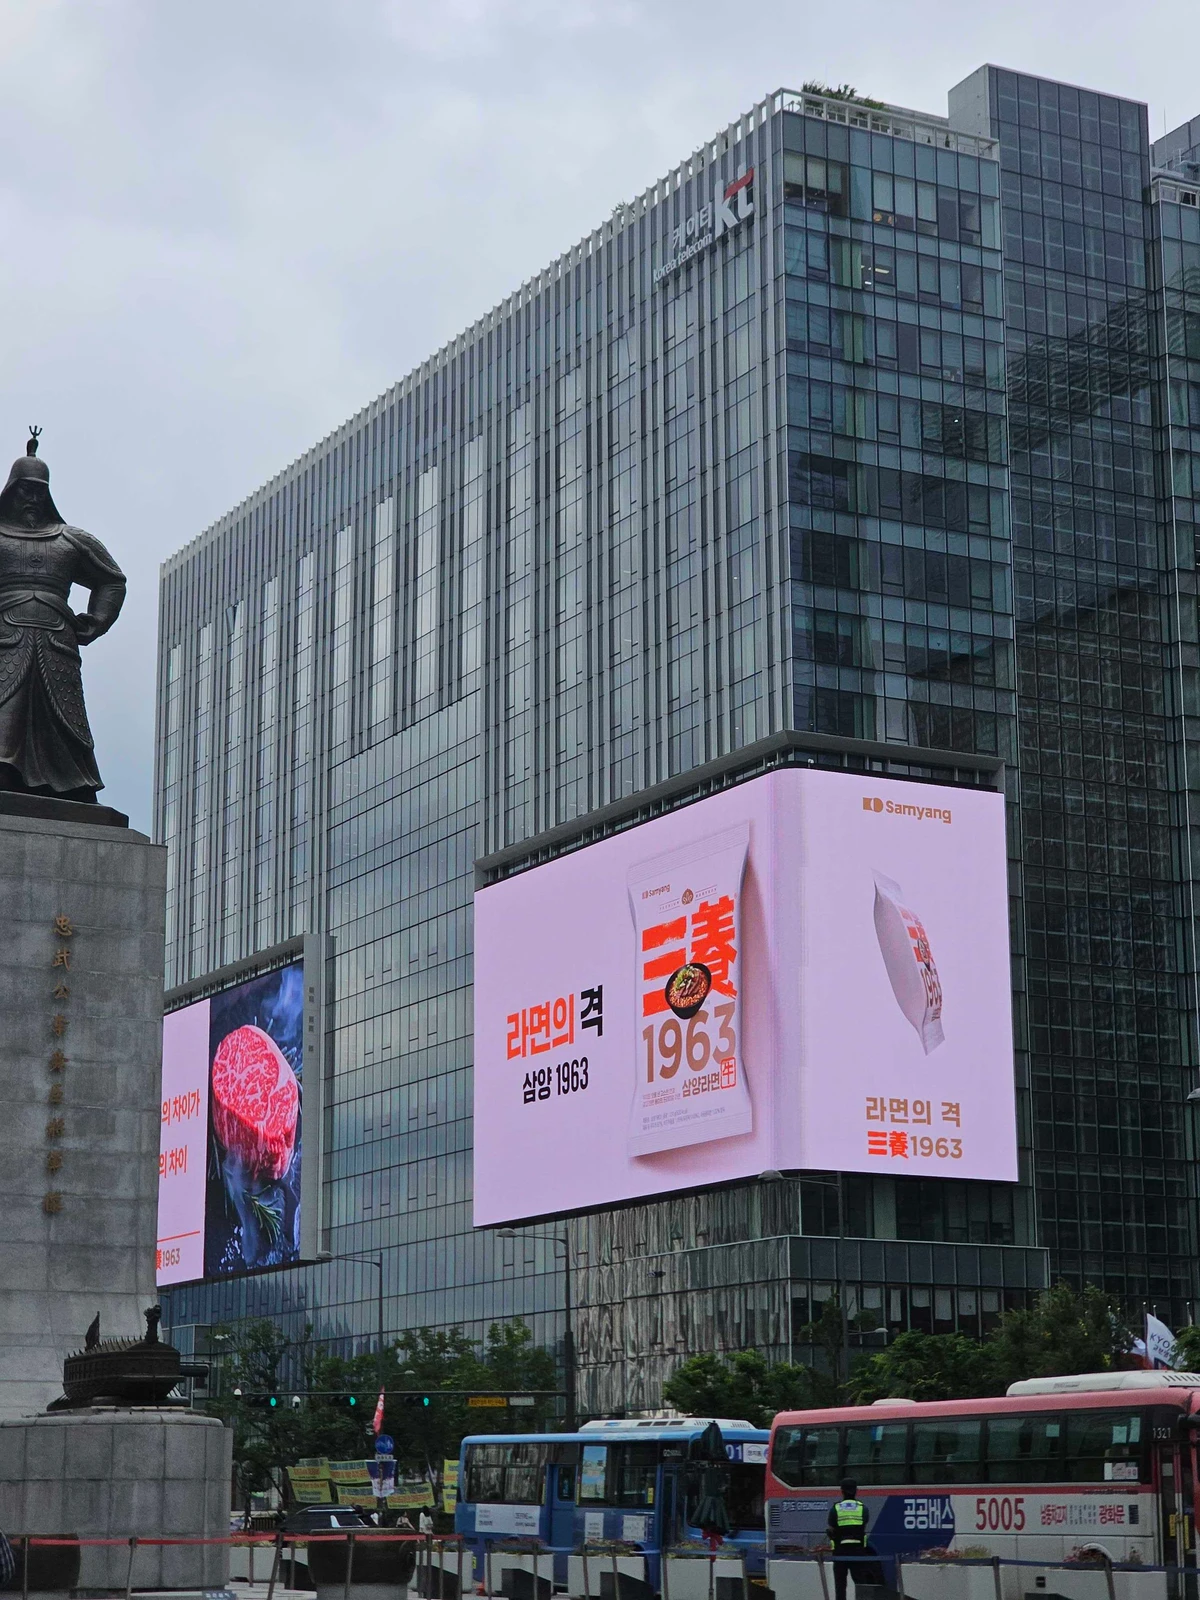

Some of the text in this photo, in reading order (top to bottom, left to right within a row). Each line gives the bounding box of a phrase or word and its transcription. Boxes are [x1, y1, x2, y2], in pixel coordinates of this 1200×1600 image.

[715, 163, 754, 240] kt
[672, 202, 712, 248] 케이티
[886, 800, 951, 824] Samyang
[507, 984, 603, 1060] 라면의 격
[642, 1002, 736, 1083] 1963
[523, 1057, 589, 1104] 삼양 1963
[682, 1071, 720, 1098] 삼양라면
[172, 1088, 200, 1122] 차이가
[866, 1097, 961, 1127] 라면의 격
[169, 1144, 187, 1176] 차이
[726, 1445, 742, 1459] 01
[904, 1498, 953, 1529] 공공버스
[976, 1497, 1025, 1531] 5005
[1099, 1504, 1125, 1525] 광화문
